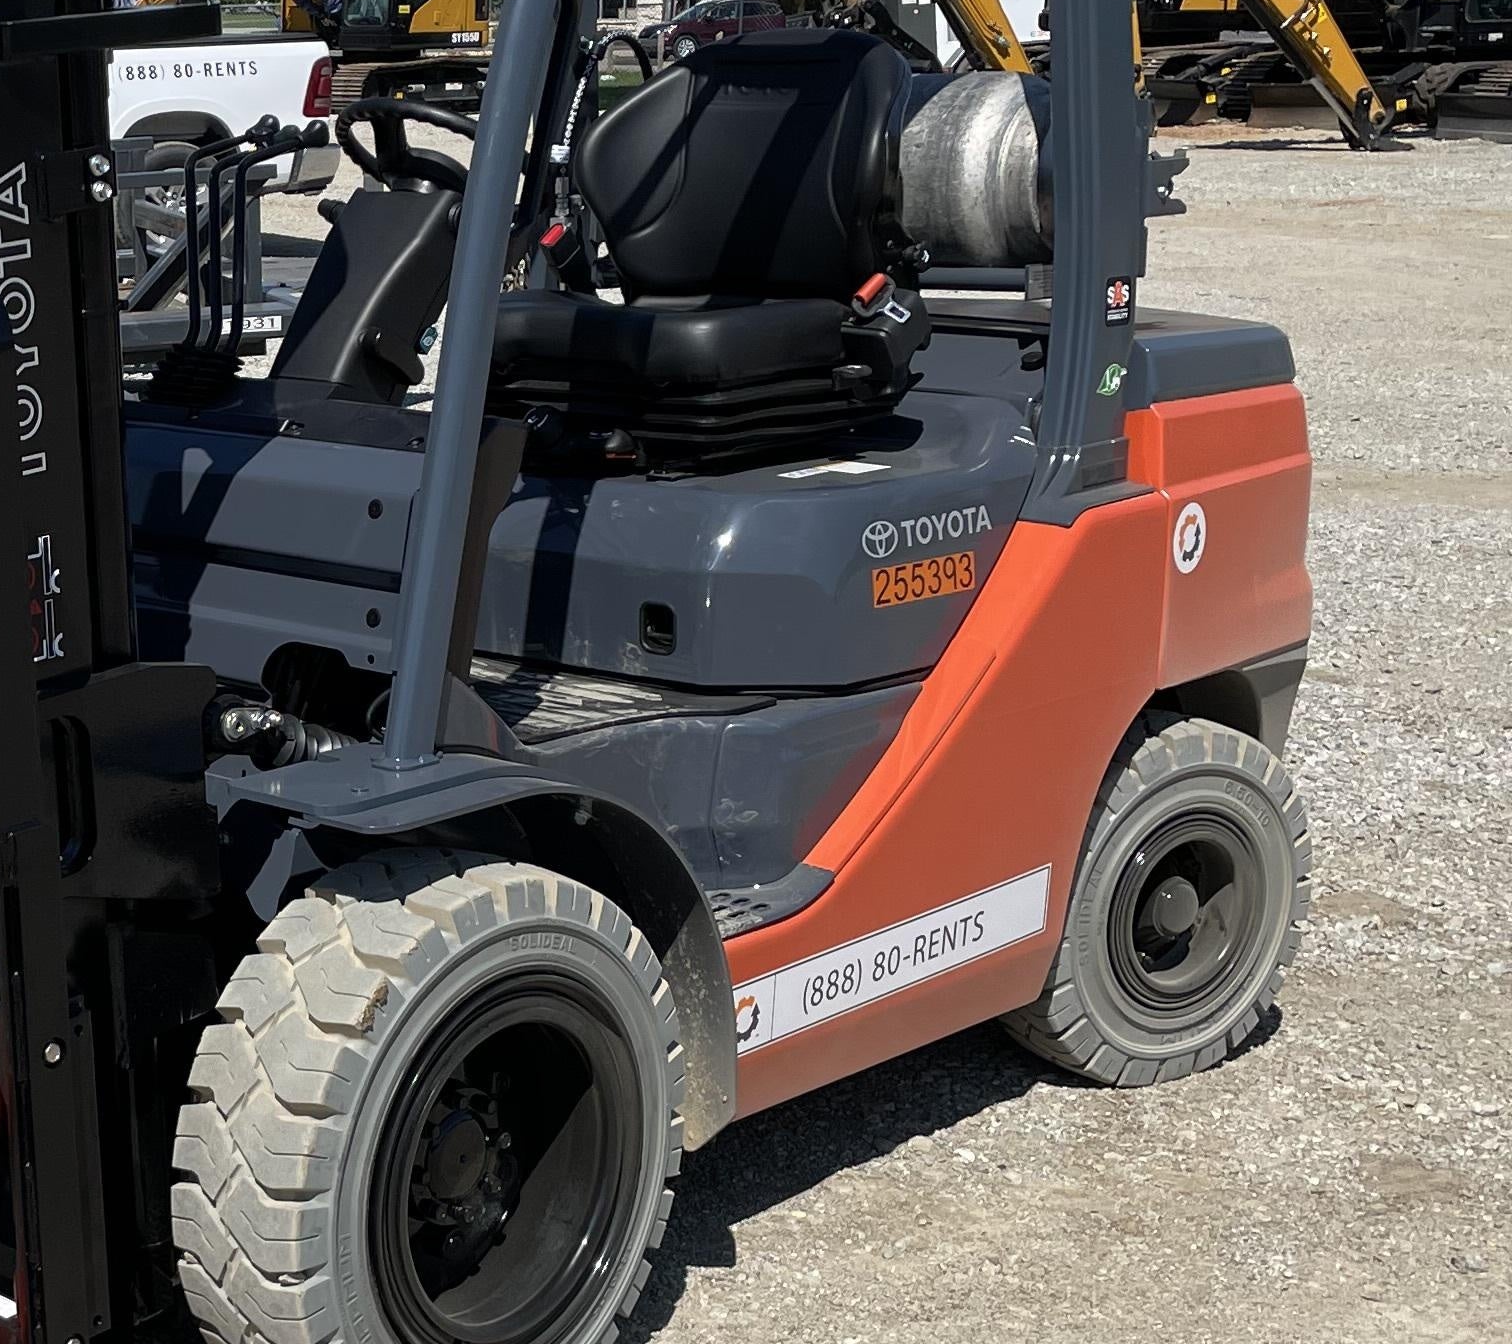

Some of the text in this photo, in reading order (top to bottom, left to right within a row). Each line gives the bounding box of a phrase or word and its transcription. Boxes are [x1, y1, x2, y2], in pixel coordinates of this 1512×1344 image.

[118, 60, 258, 82] (888) 80-RENTS
[227, 317, 276, 330] 931
[900, 504, 993, 547] TOYOTA
[875, 553, 974, 606] 255393
[509, 932, 577, 955] SOLIDEAL
[802, 910, 985, 1015] (888) 80-RENTS
